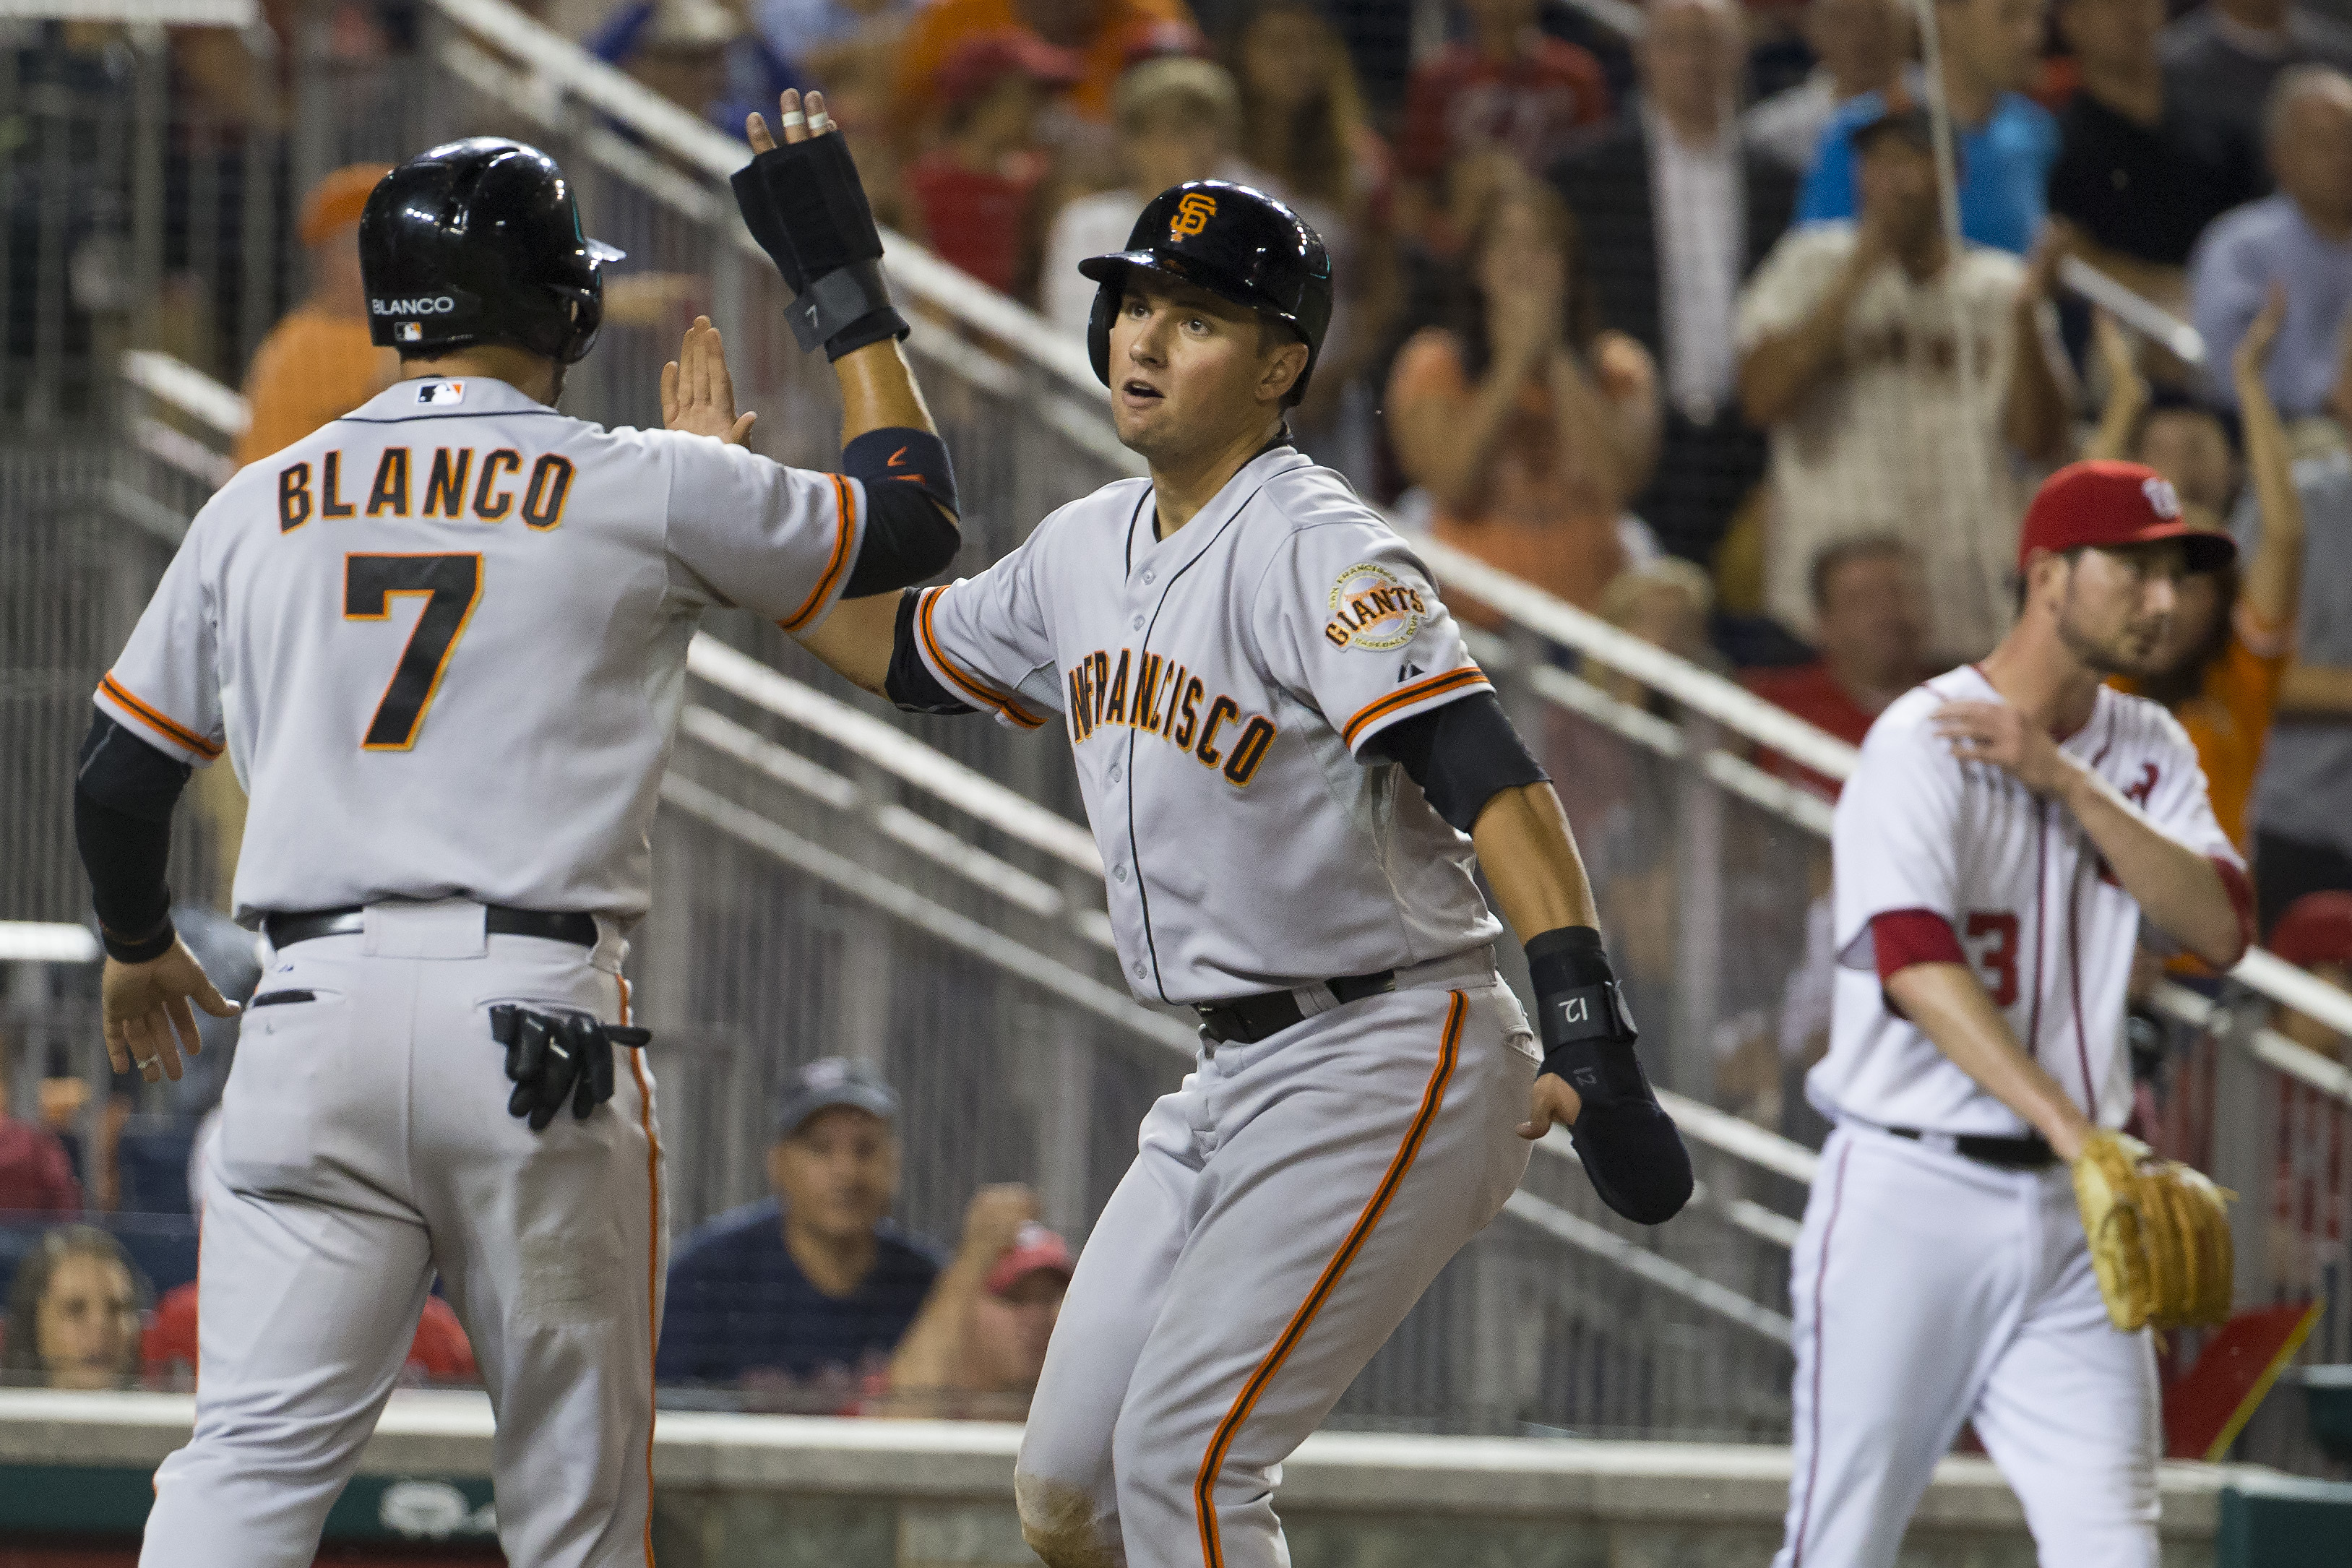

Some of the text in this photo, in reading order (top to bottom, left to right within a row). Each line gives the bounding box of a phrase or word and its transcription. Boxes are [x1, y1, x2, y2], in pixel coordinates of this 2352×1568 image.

[372, 296, 455, 315] BLANCO
[805, 304, 818, 328] 7
[277, 447, 577, 535] BLANCO
[1325, 586, 1426, 647] GIANTS
[343, 551, 486, 752] 7
